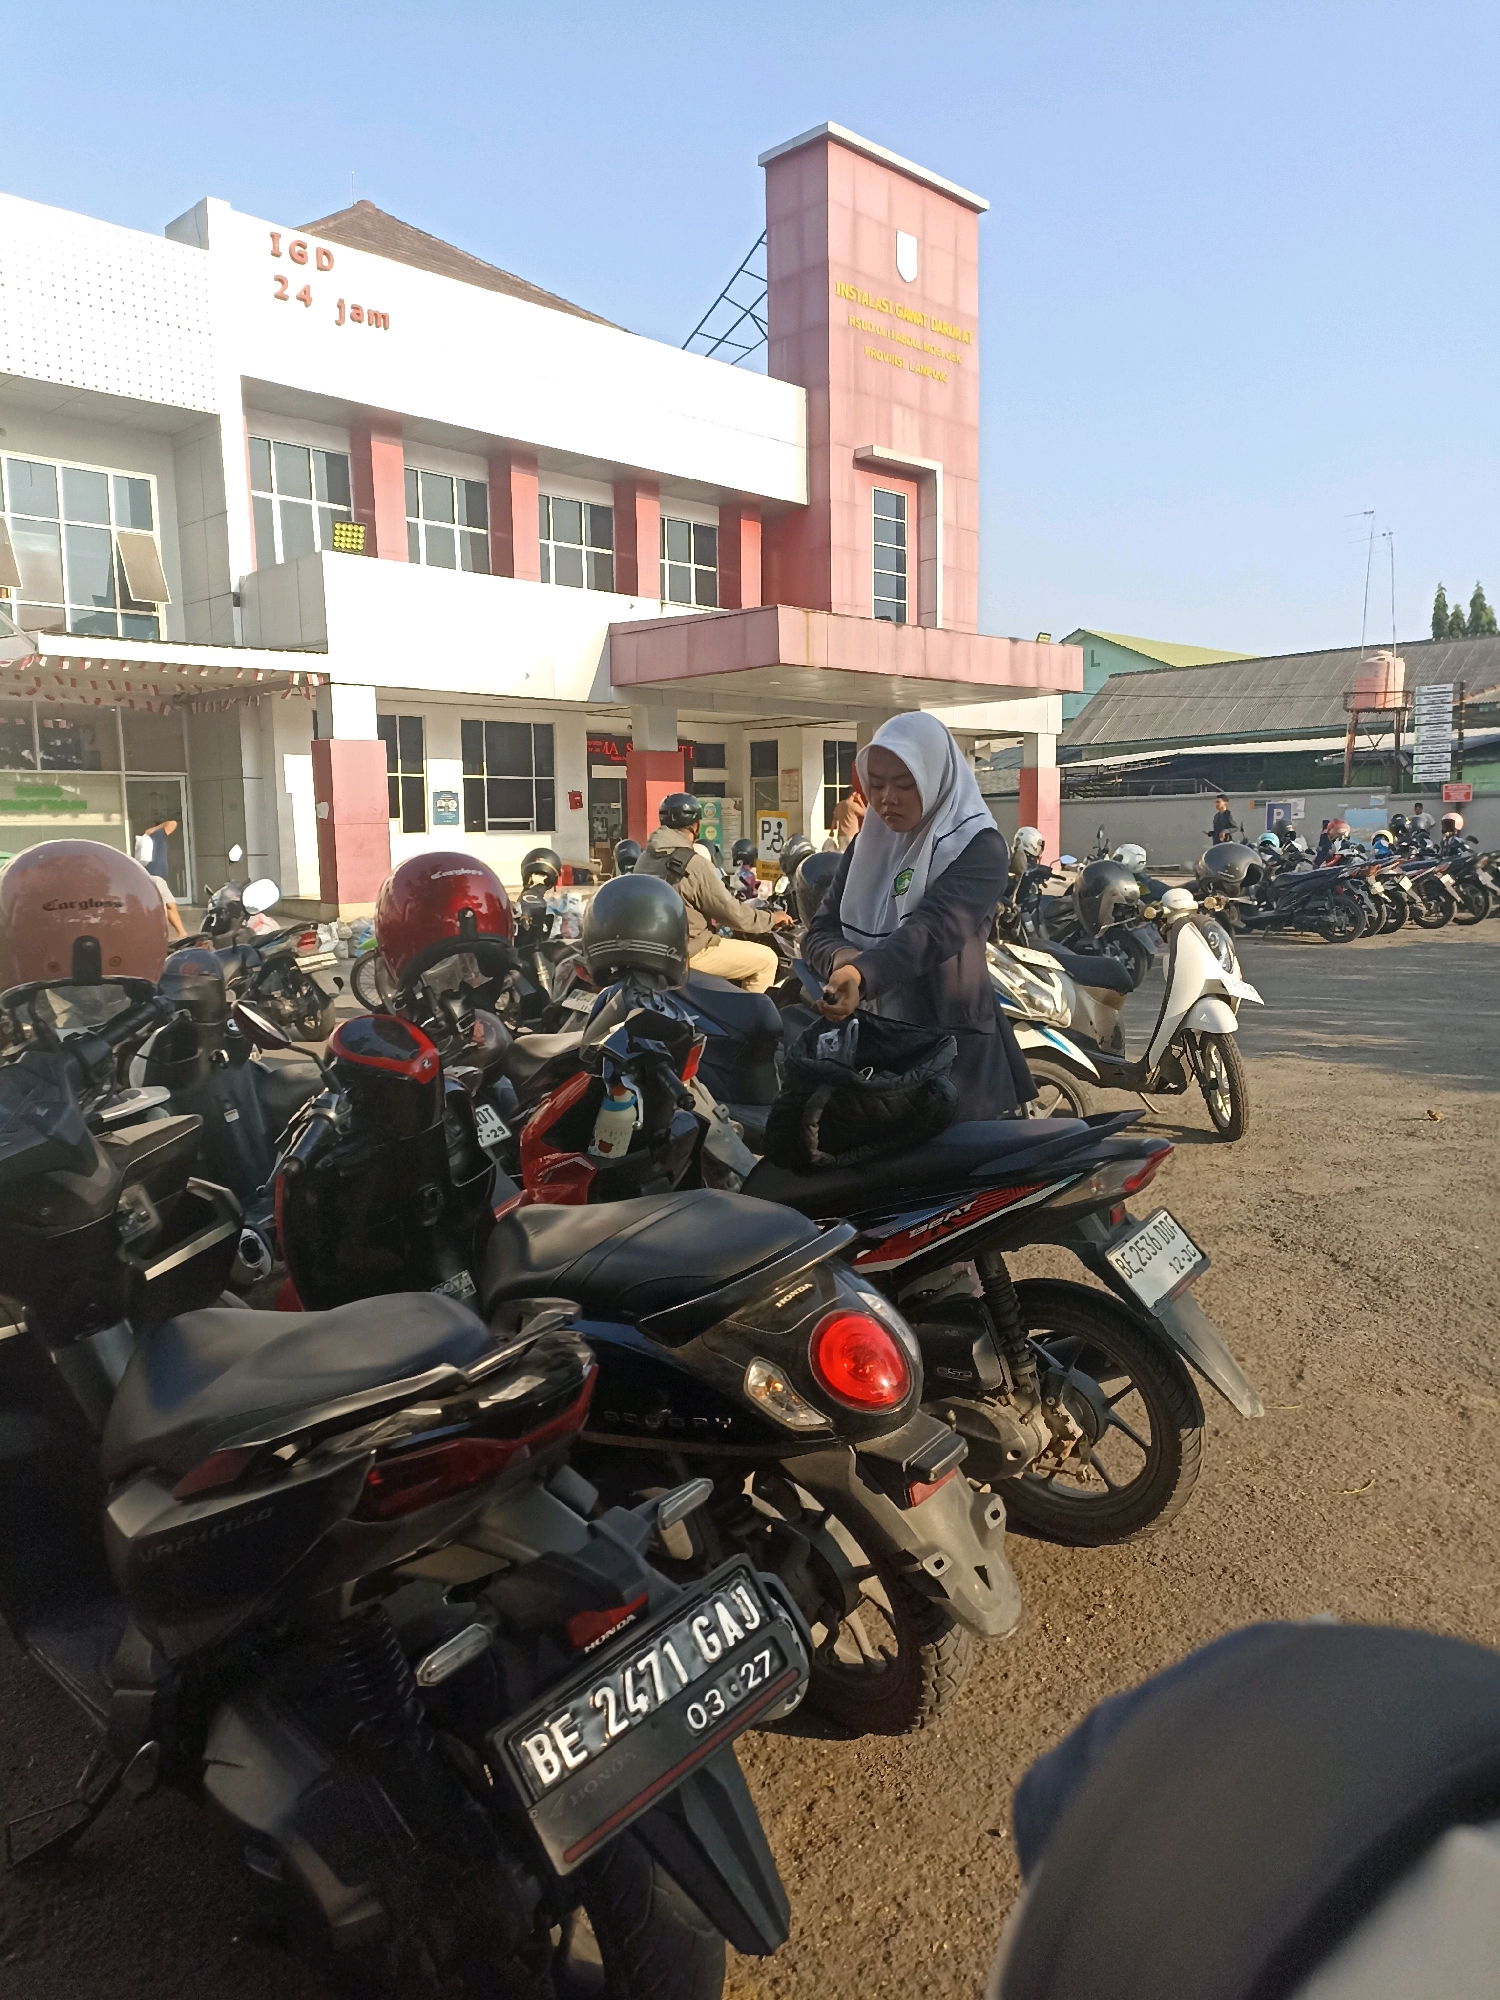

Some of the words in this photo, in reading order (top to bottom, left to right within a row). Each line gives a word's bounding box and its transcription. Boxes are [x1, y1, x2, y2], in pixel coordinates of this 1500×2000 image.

[270, 231, 334, 272] IGD
[274, 274, 313, 308] 24
[835, 281, 894, 315] INSTALASI
[895, 303, 928, 328] GAWAT
[930, 317, 974, 345] DARURAT
[909, 362, 949, 383] LAMPUNG
[761, 820, 772, 840] P
[1273, 809, 1285, 823] P
[42, 897, 124, 912] Cargloss
[1114, 1252, 1142, 1279] BE
[1128, 1232, 1163, 1267] 2536
[774, 1283, 814, 1308] HONDA
[583, 1612, 637, 1654] HONDA
[521, 1712, 588, 1788] BE
[592, 1640, 690, 1740] 2471
[690, 1585, 761, 1664] GAJ
